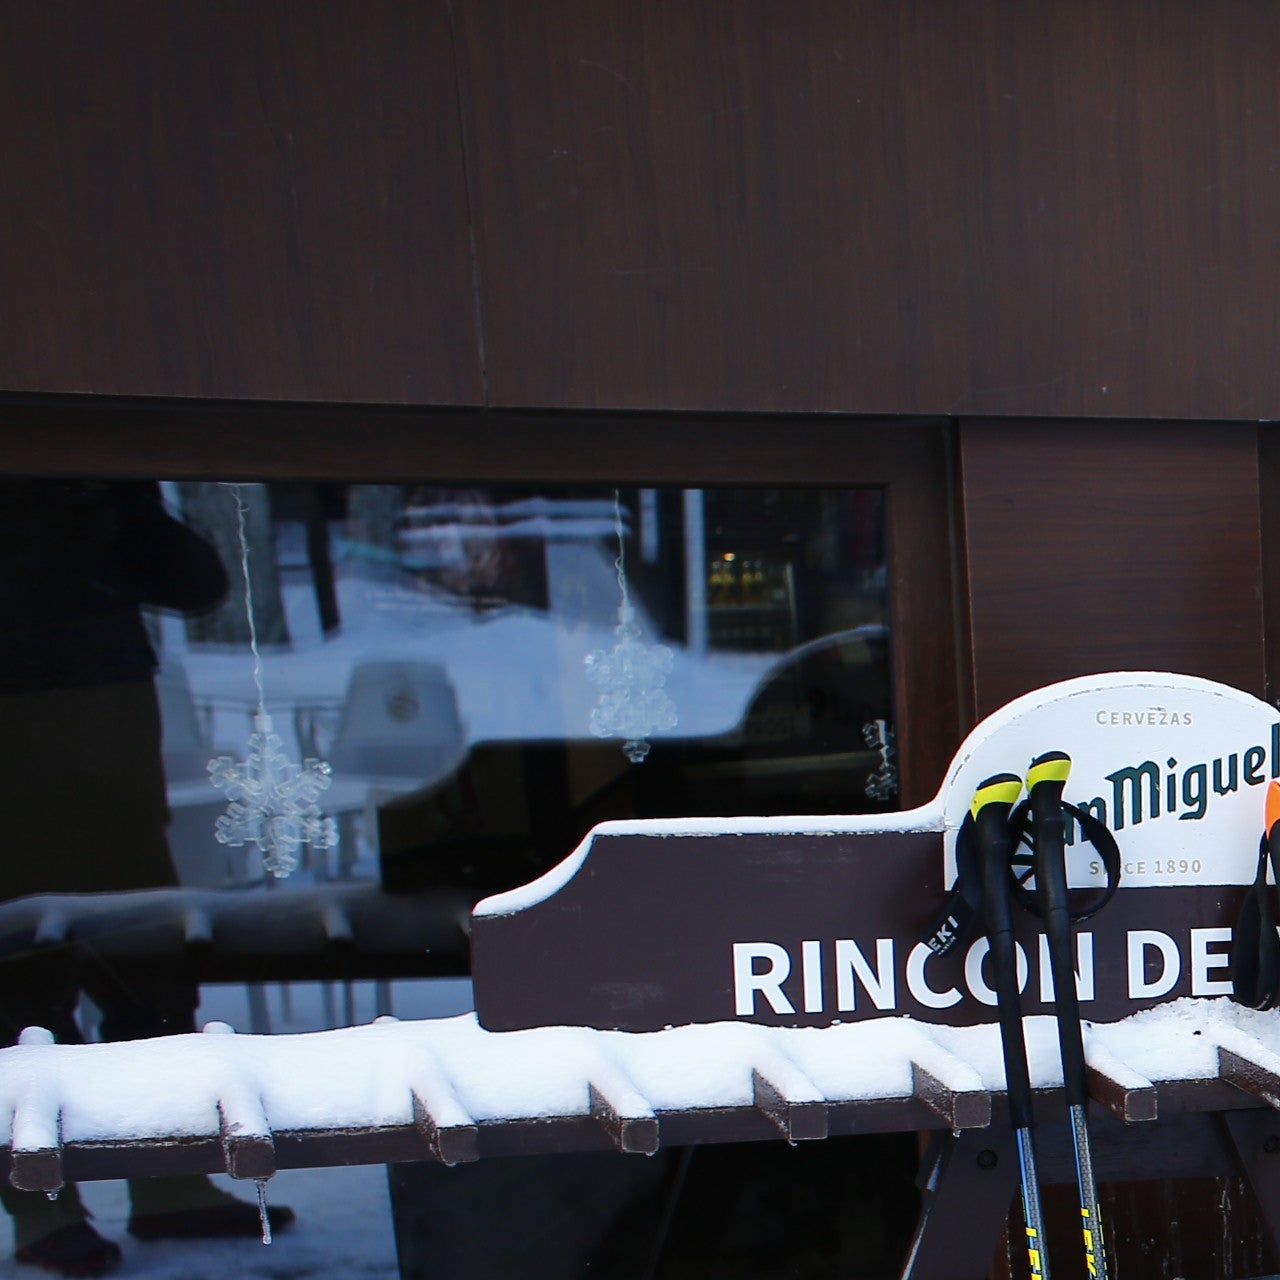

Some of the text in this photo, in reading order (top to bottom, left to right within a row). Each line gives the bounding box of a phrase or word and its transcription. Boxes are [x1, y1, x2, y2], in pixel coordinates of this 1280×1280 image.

[1095, 709, 1193, 726] CERVEZAS
[1105, 722, 1280, 832] Miguel
[1089, 859, 1202, 875] SCE 1890
[928, 915, 960, 953] EKI
[1127, 927, 1236, 999] DE
